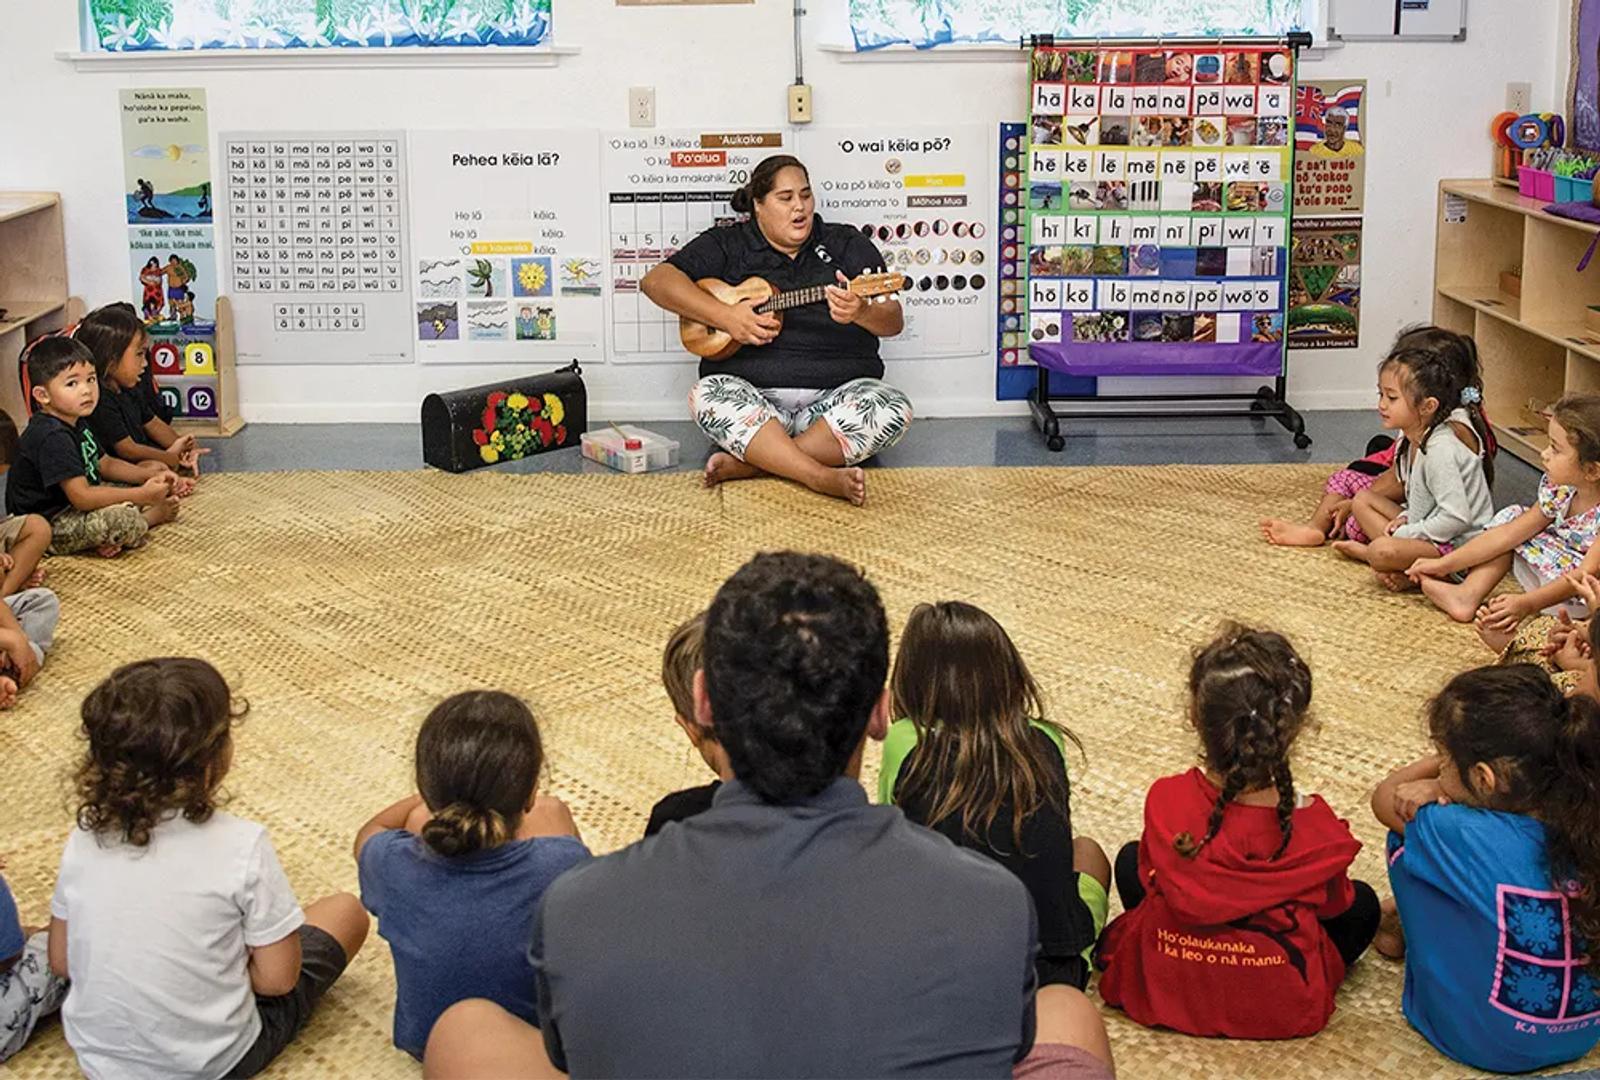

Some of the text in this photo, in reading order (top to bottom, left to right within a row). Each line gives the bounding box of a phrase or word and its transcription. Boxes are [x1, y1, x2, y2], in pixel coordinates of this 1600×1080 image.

[655, 136, 665, 145] 13
[838, 138, 951, 153] 'O wai kēia pō?
[231, 146, 244, 154] ha
[253, 146, 265, 154] ka
[274, 146, 284, 154] la
[337, 146, 351, 154] pa
[383, 145, 392, 153] 'a
[453, 153, 559, 166] Pehea kēia lā?
[677, 153, 720, 163] Po'alua
[729, 170, 748, 185] 20
[235, 236, 248, 244] ho
[278, 236, 287, 244] lo
[386, 235, 395, 243] 'o
[620, 234, 678, 245] 4 5 6
[280, 266, 289, 274] lu
[342, 267, 355, 275] pu
[160, 352, 203, 364] 7 8
[195, 395, 207, 406] 12
[1158, 929, 1255, 953] Ho'olaukanaka
[1165, 944, 1177, 957] ka
[1183, 948, 1202, 960] leo
[1207, 955, 1216, 963] o
[1221, 955, 1237, 965] nā
[1242, 956, 1285, 966] manu.
[1515, 1021, 1536, 1034] KA
